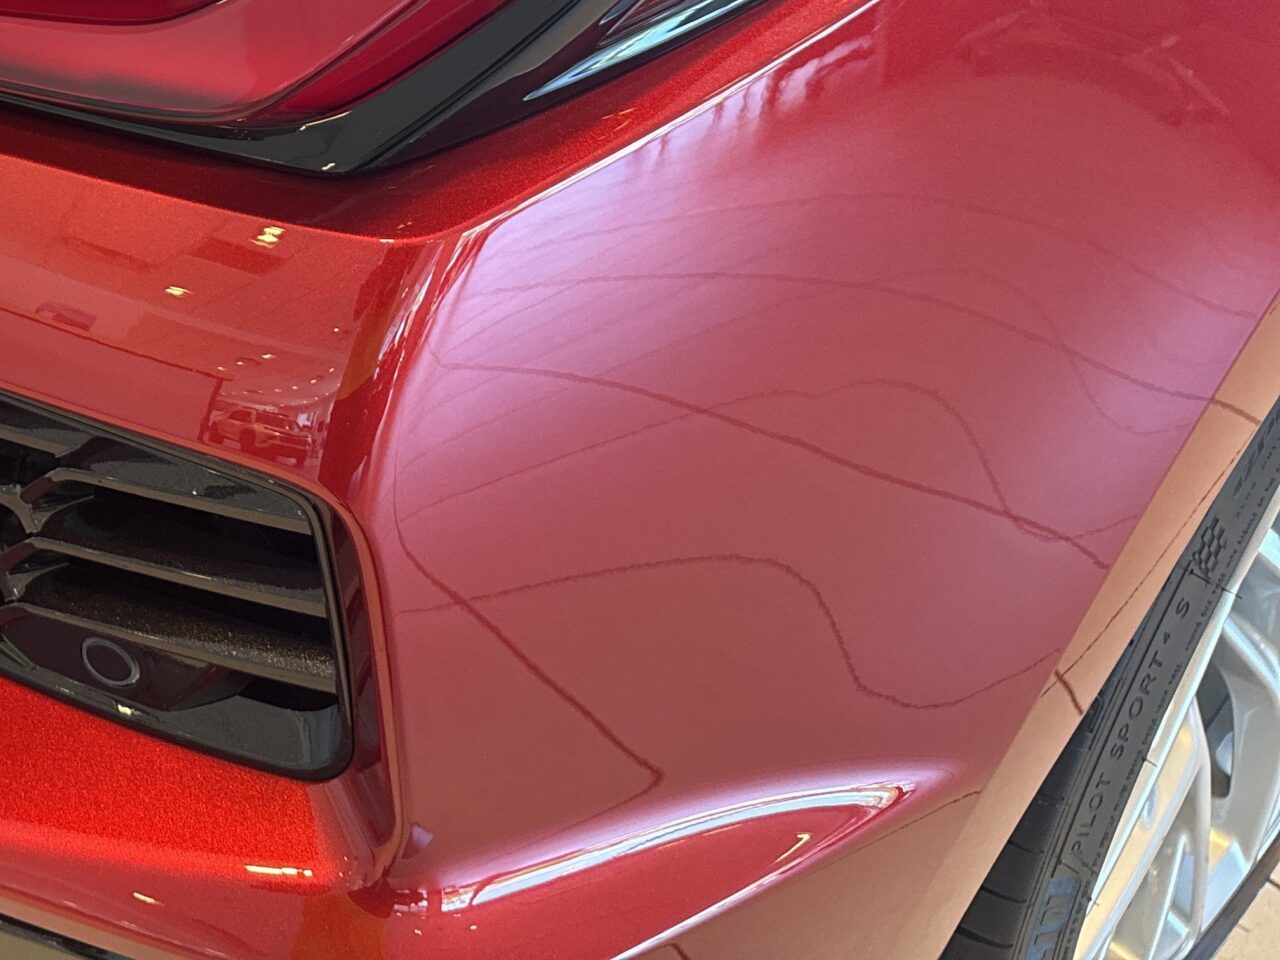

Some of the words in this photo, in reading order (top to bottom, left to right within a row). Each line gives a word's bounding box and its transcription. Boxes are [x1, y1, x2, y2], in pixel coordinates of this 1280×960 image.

[1071, 771, 1111, 854] PILOT
[1110, 649, 1163, 761] SPORT
[1175, 596, 1191, 619] S
